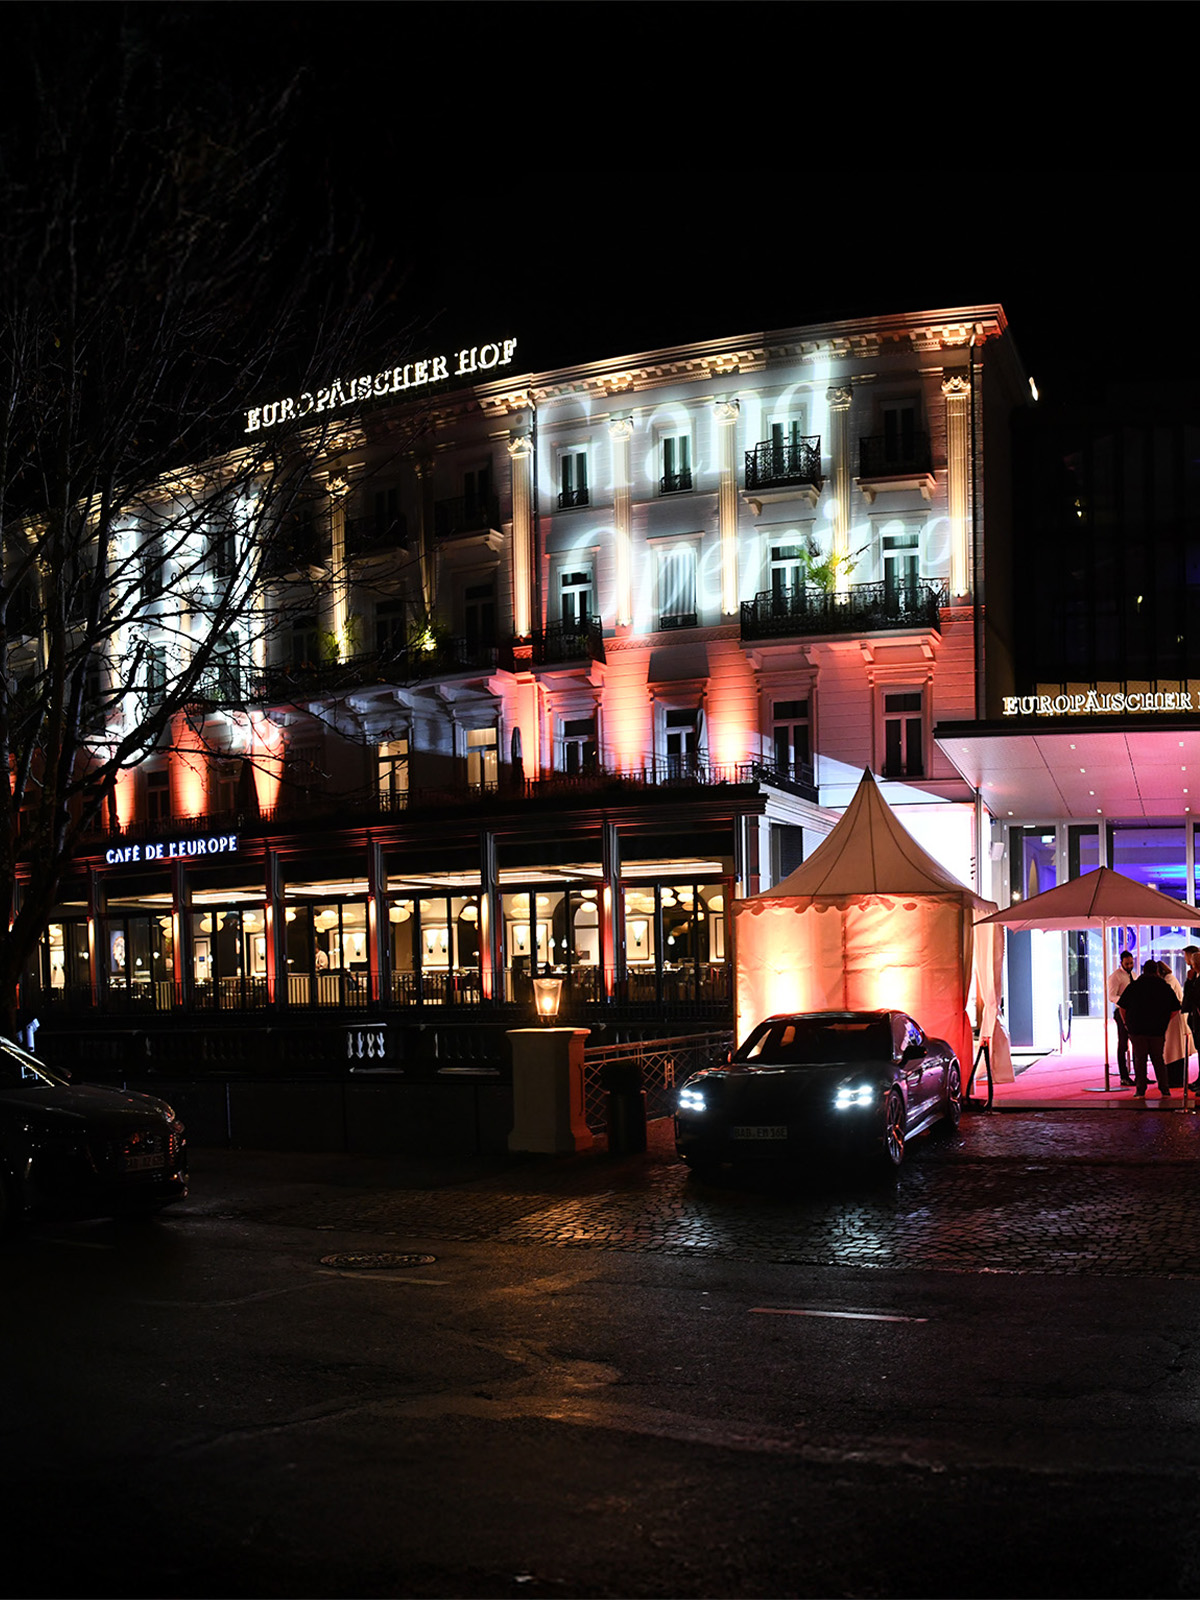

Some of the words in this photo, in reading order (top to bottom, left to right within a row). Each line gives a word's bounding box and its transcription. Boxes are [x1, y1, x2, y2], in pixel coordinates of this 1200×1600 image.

[243, 355, 449, 434] EUROPÄISCHER
[454, 337, 517, 376] HOF
[536, 347, 833, 498] Grand
[1002, 689, 1192, 716] EUROPÄISCHER
[105, 844, 141, 865] CAFÉ
[145, 842, 164, 861] DE
